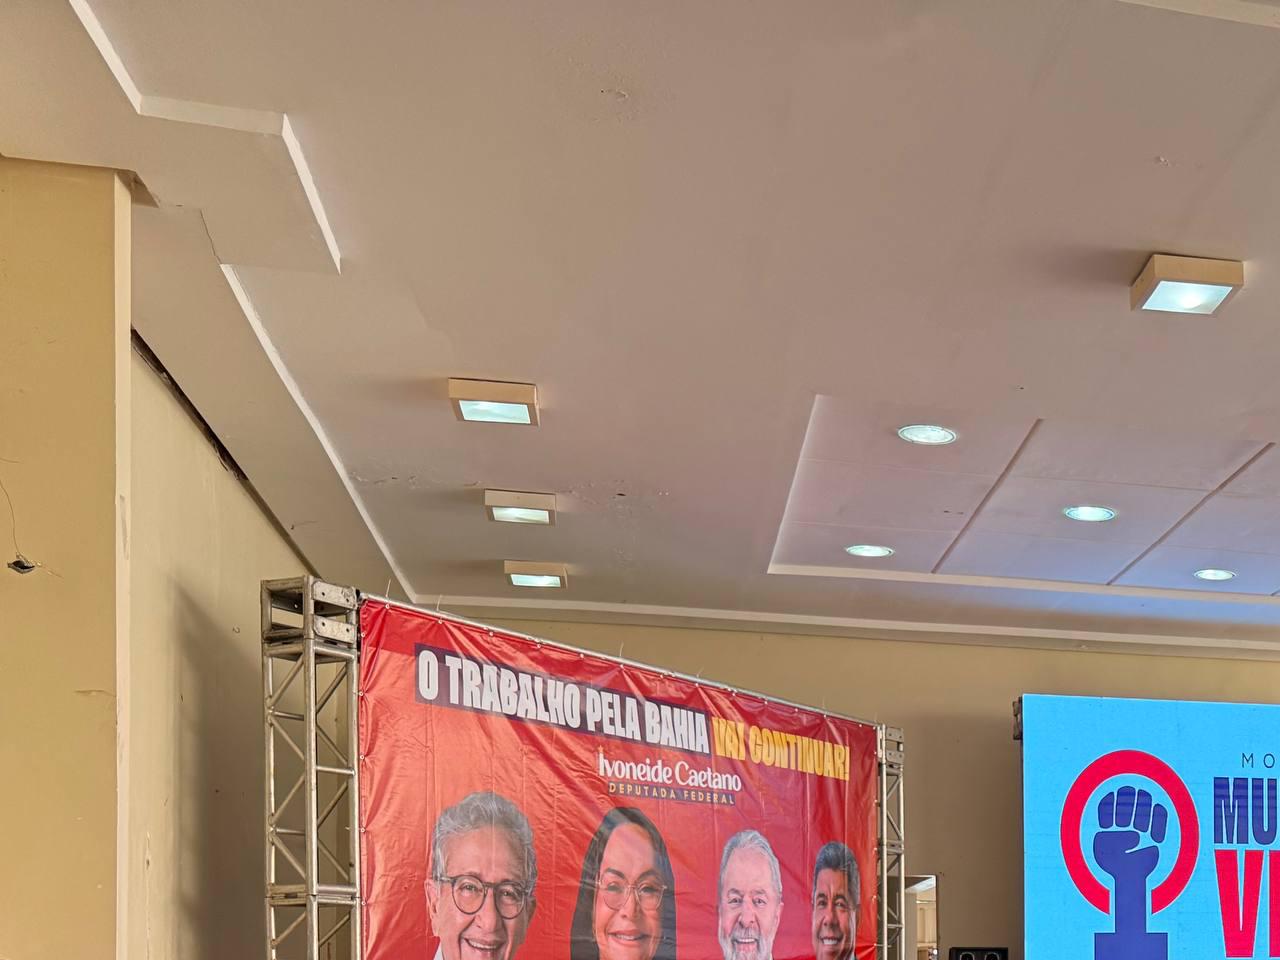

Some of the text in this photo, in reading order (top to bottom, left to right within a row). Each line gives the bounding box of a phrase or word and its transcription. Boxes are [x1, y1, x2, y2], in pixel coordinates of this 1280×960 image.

[418, 649, 850, 781] O TRABALHO PELA BAHIA VAI CONTINUAR!
[598, 750, 743, 792] Ivoneide Caetano
[608, 782, 736, 805] DEPUTADA FEDERAL
